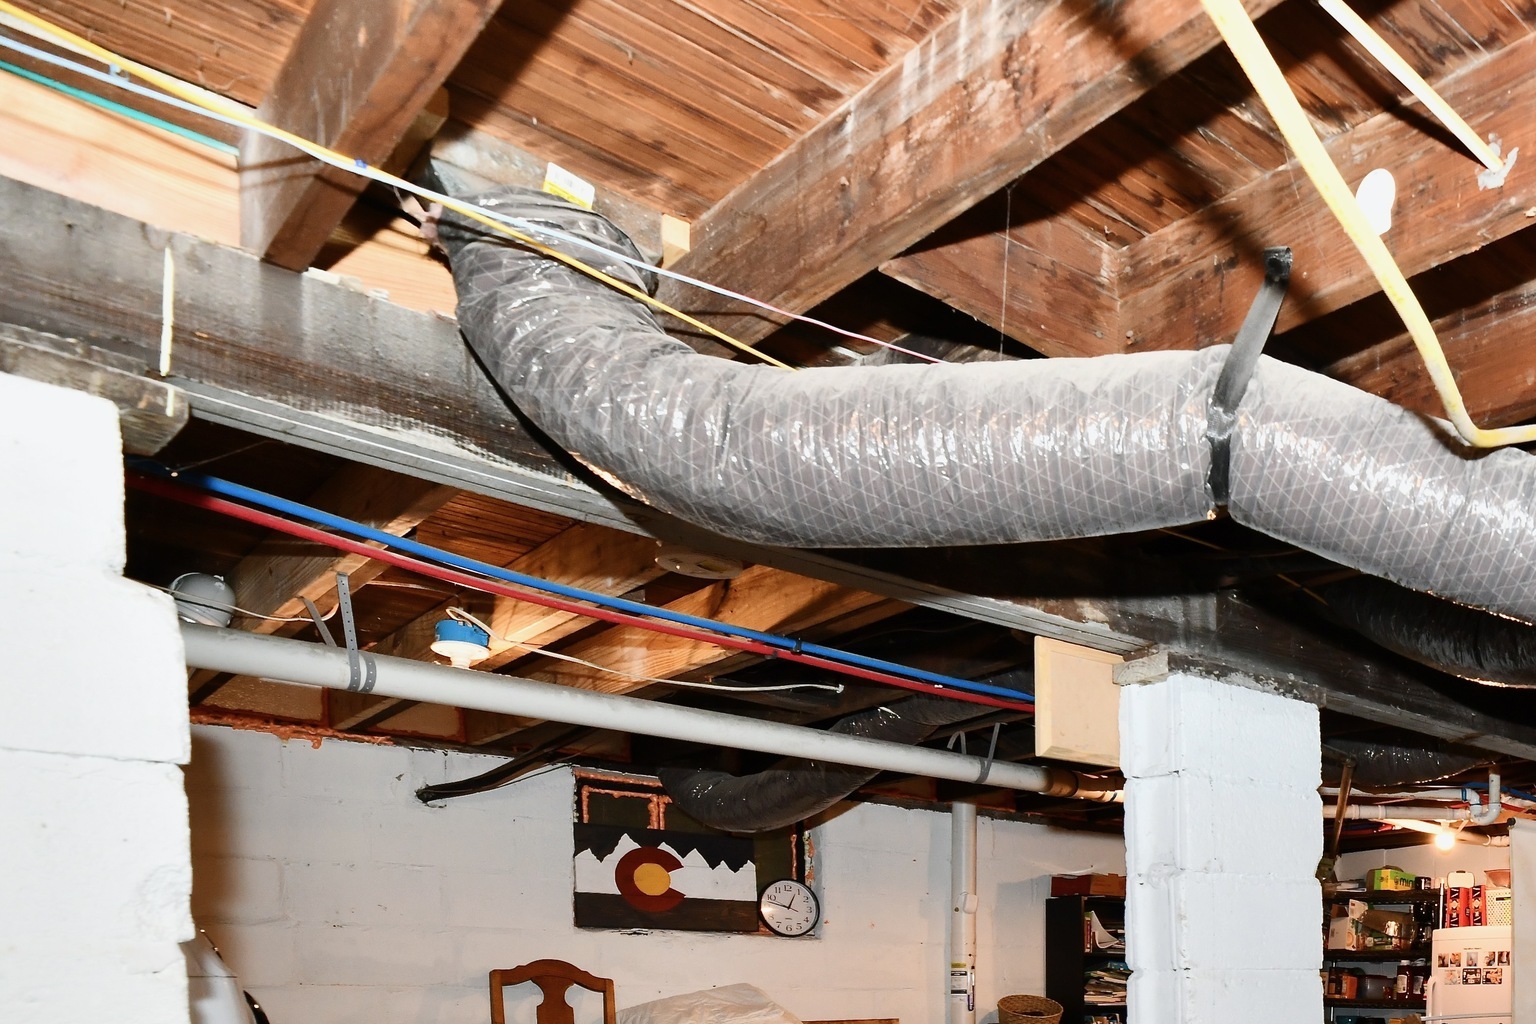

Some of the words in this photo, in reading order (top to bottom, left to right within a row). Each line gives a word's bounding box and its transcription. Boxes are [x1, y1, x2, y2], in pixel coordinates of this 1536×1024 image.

[775, 886, 781, 894] 11
[784, 884, 792, 892] 12
[807, 906, 812, 914] 3
[796, 922, 802, 930] 5
